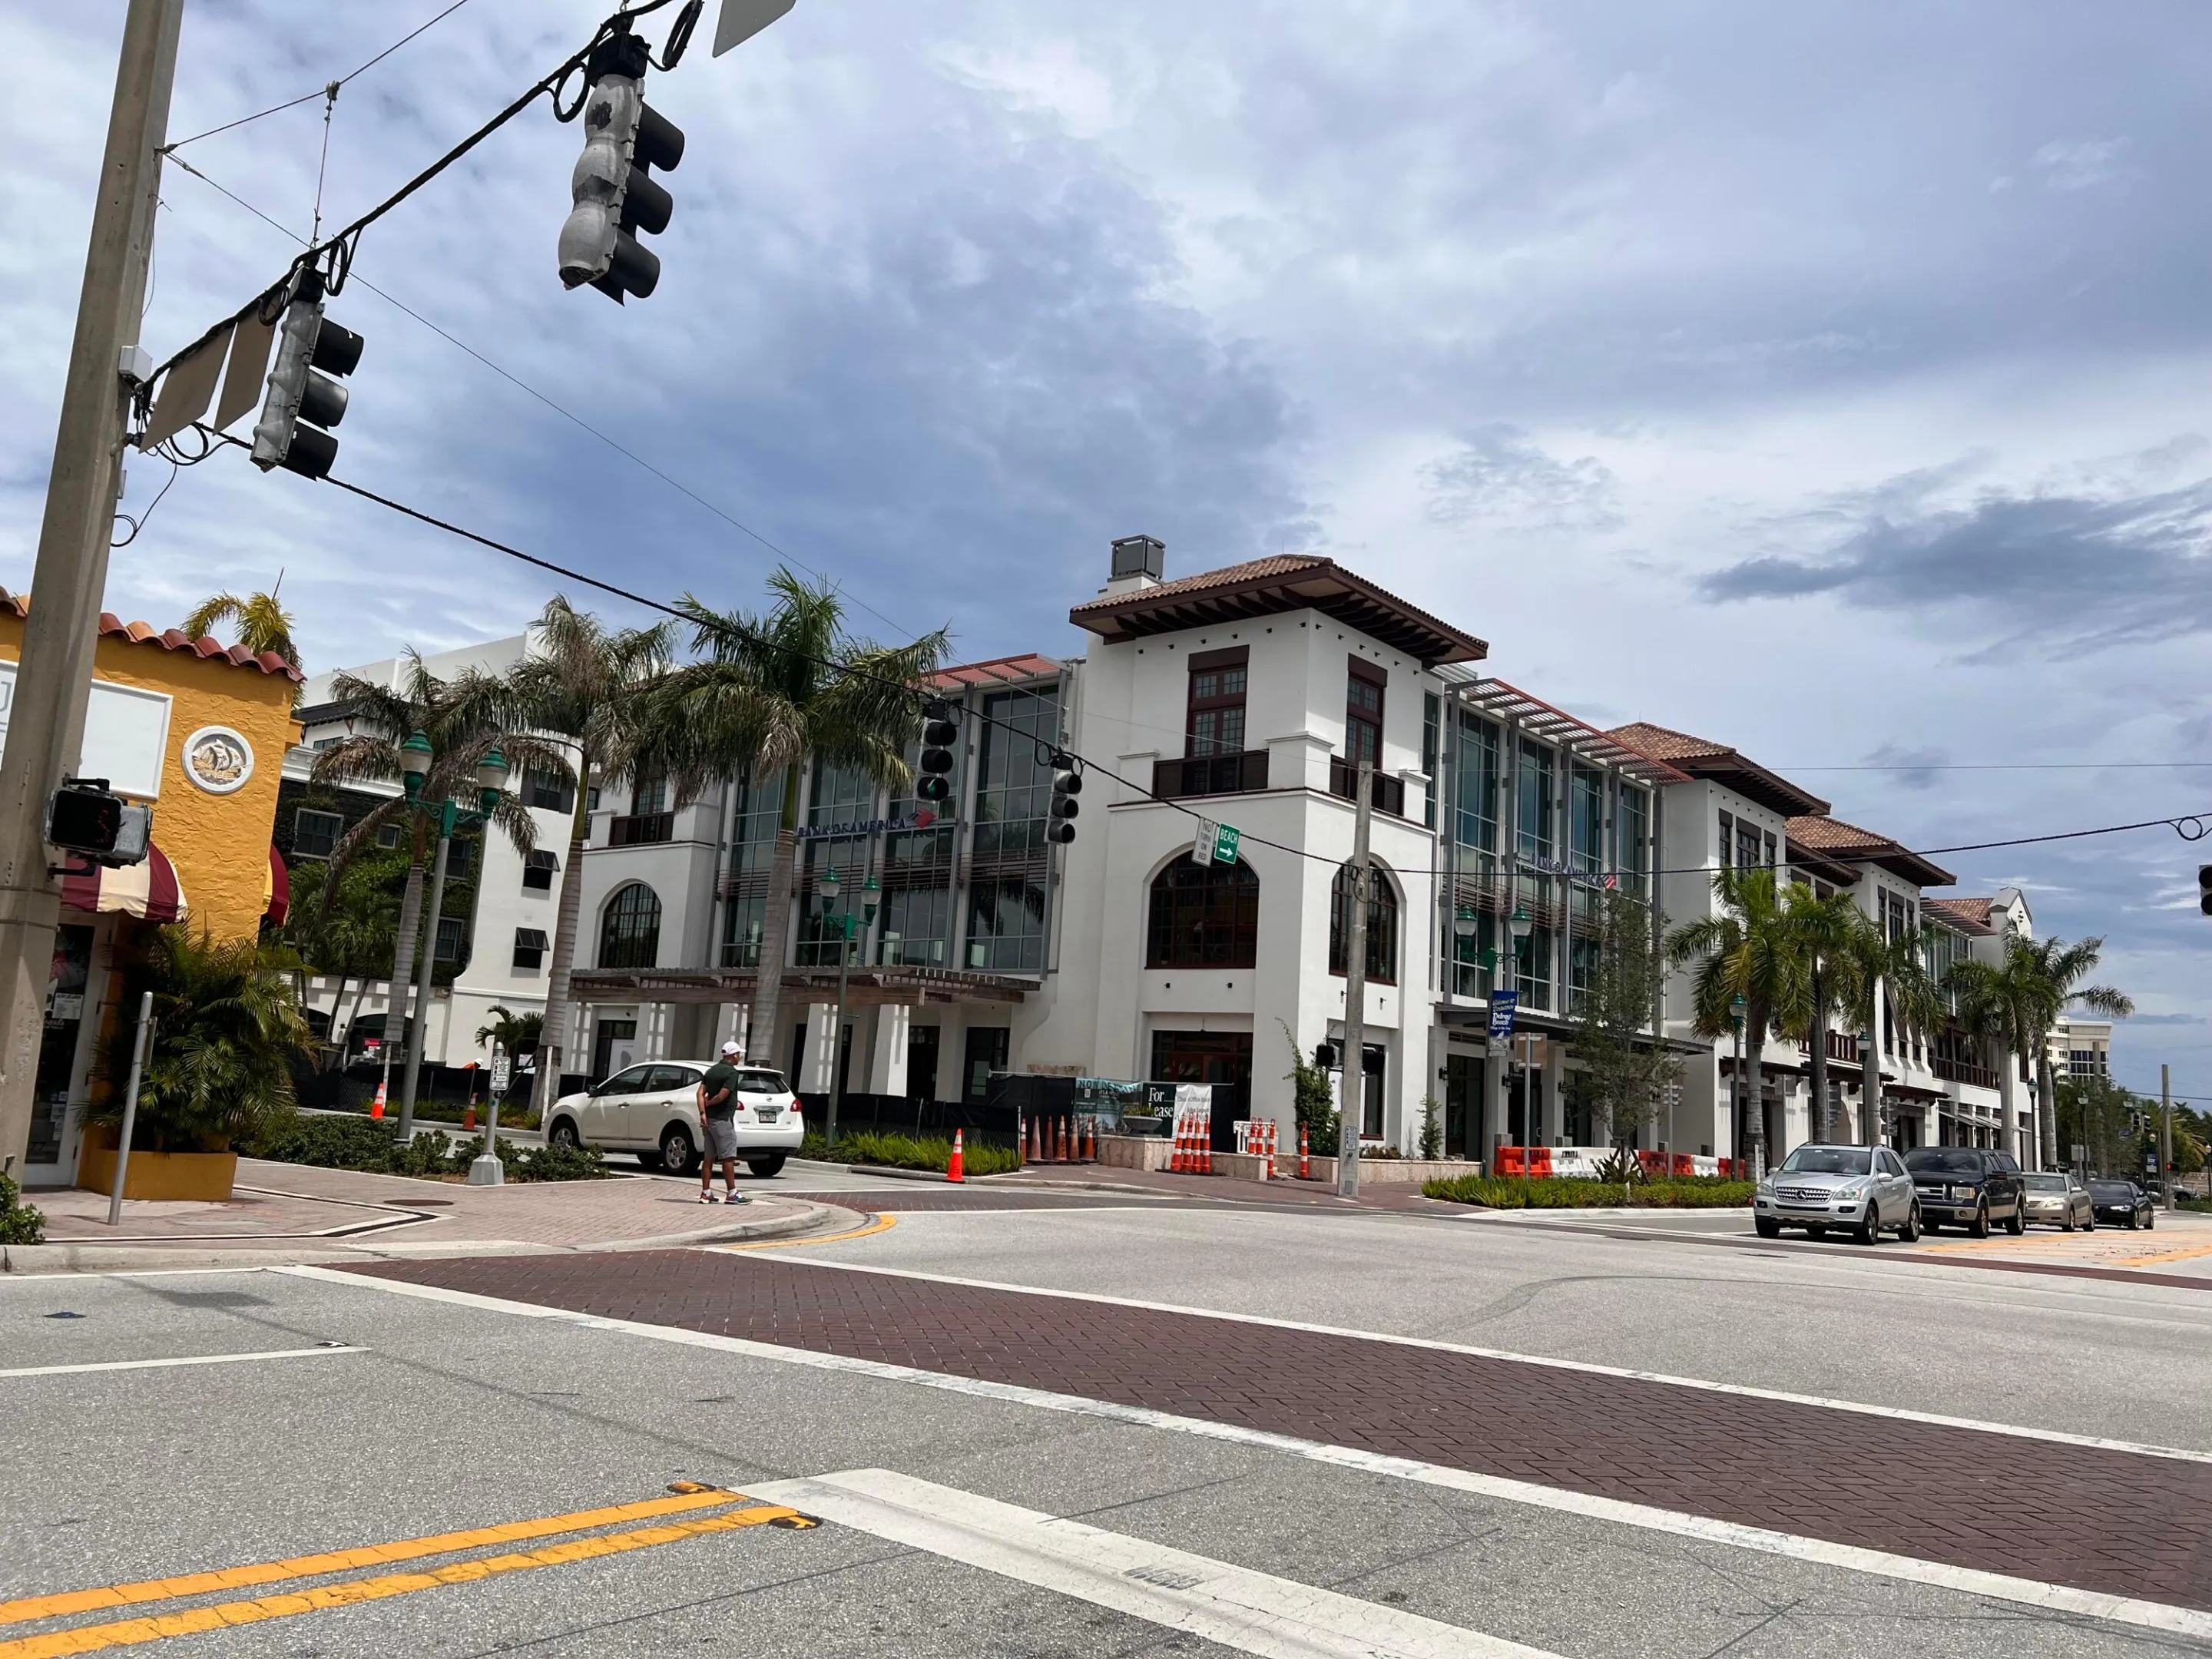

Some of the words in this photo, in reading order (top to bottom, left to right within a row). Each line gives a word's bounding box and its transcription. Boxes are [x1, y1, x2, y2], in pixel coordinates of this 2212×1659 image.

[798, 824, 831, 837] BANK
[833, 823, 849, 835] OF
[849, 817, 907, 833] AMERICA
[1204, 823, 1212, 833] NO
[1220, 829, 1238, 844] BEACH
[1198, 852, 1207, 860] RED
[1530, 853, 1551, 872] BANK
[1079, 1080, 1098, 1088] NOW
[1148, 1087, 1164, 1102] For
